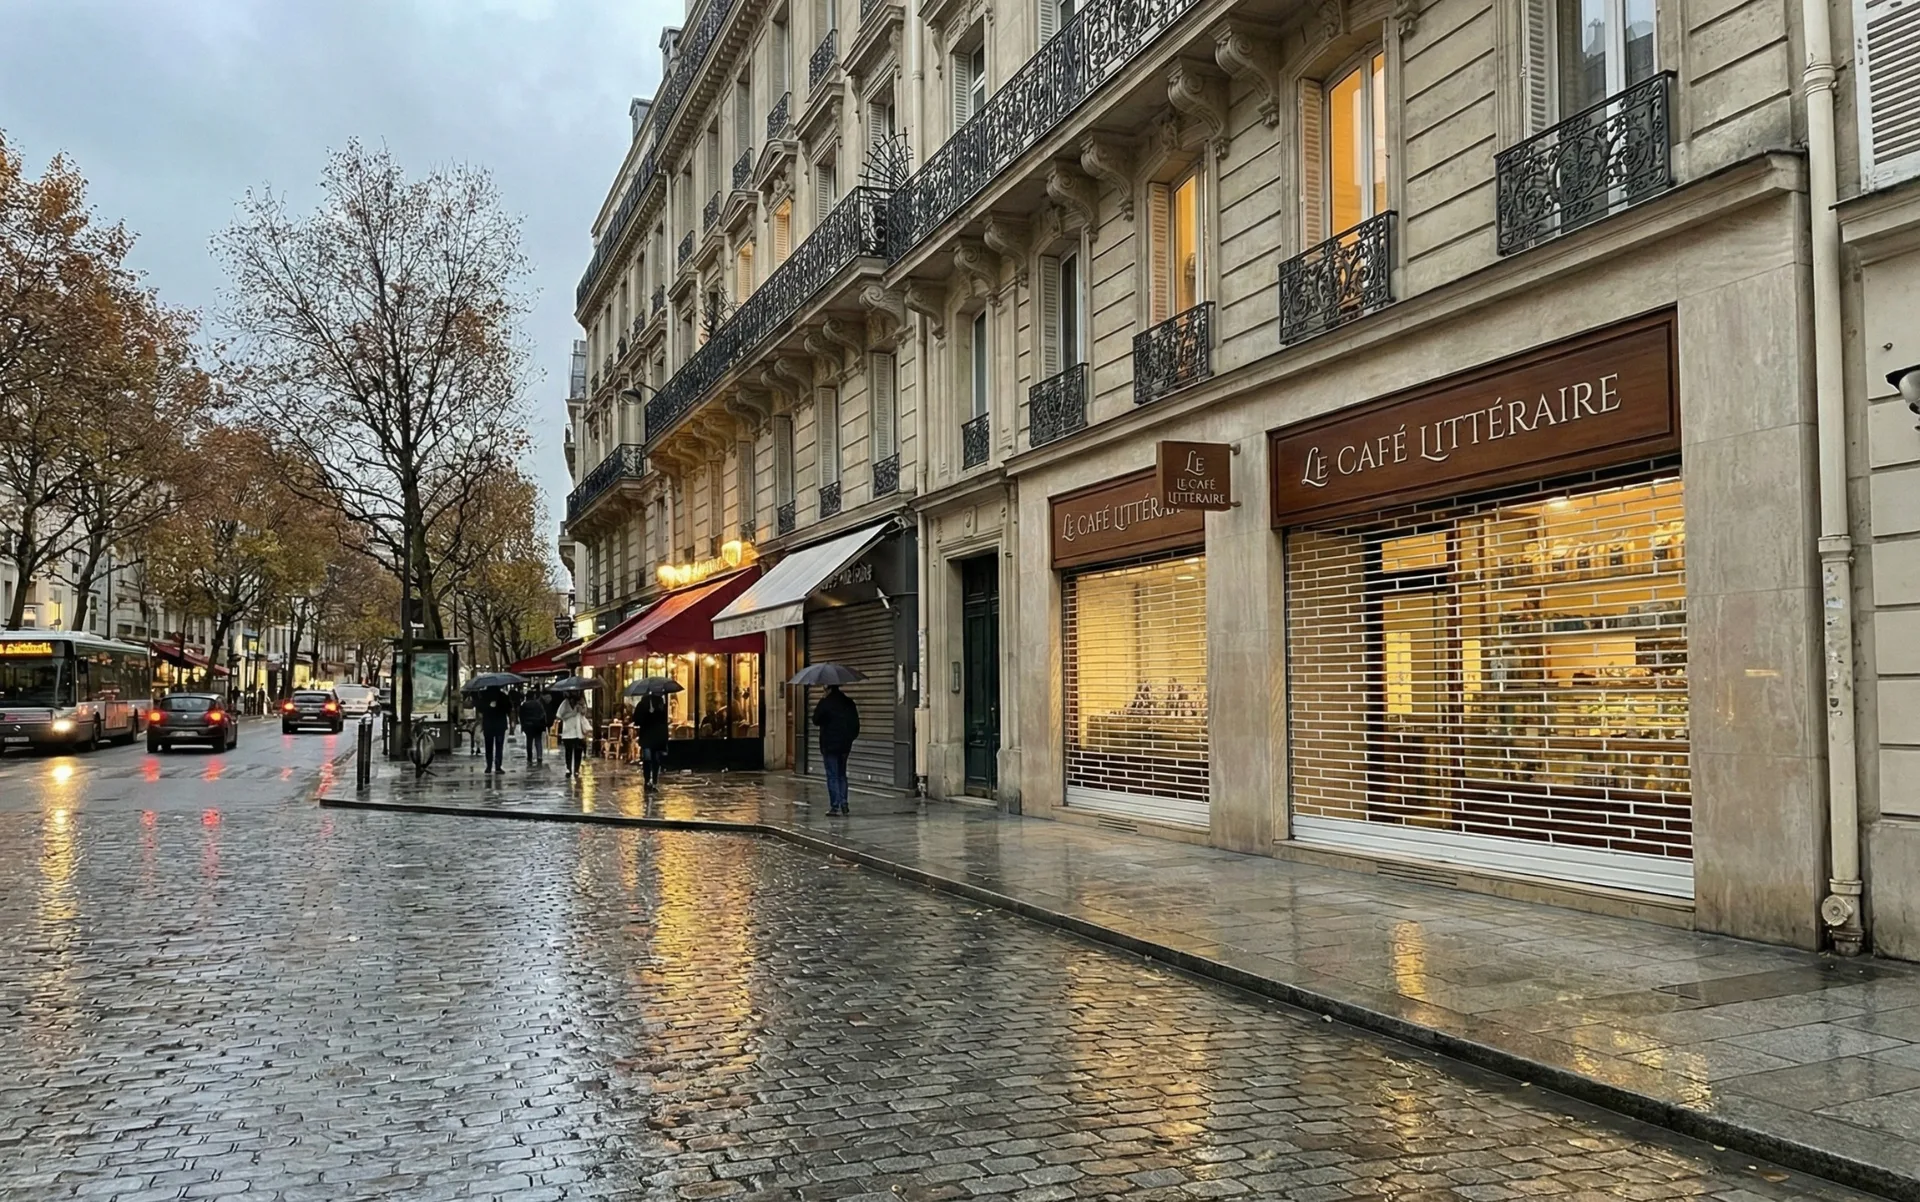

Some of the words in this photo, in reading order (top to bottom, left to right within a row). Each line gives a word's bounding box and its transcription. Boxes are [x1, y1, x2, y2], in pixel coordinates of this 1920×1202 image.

[1299, 446, 1330, 488] LE
[1336, 424, 1409, 476] CAFÉ
[1418, 372, 1623, 463] LITTÉRAIRE
[1184, 450, 1205, 476] LE
[1188, 478, 1216, 490] CAFÉ
[1077, 504, 1110, 535] CAFÉ
[1114, 493, 1186, 531] LITTÉR
